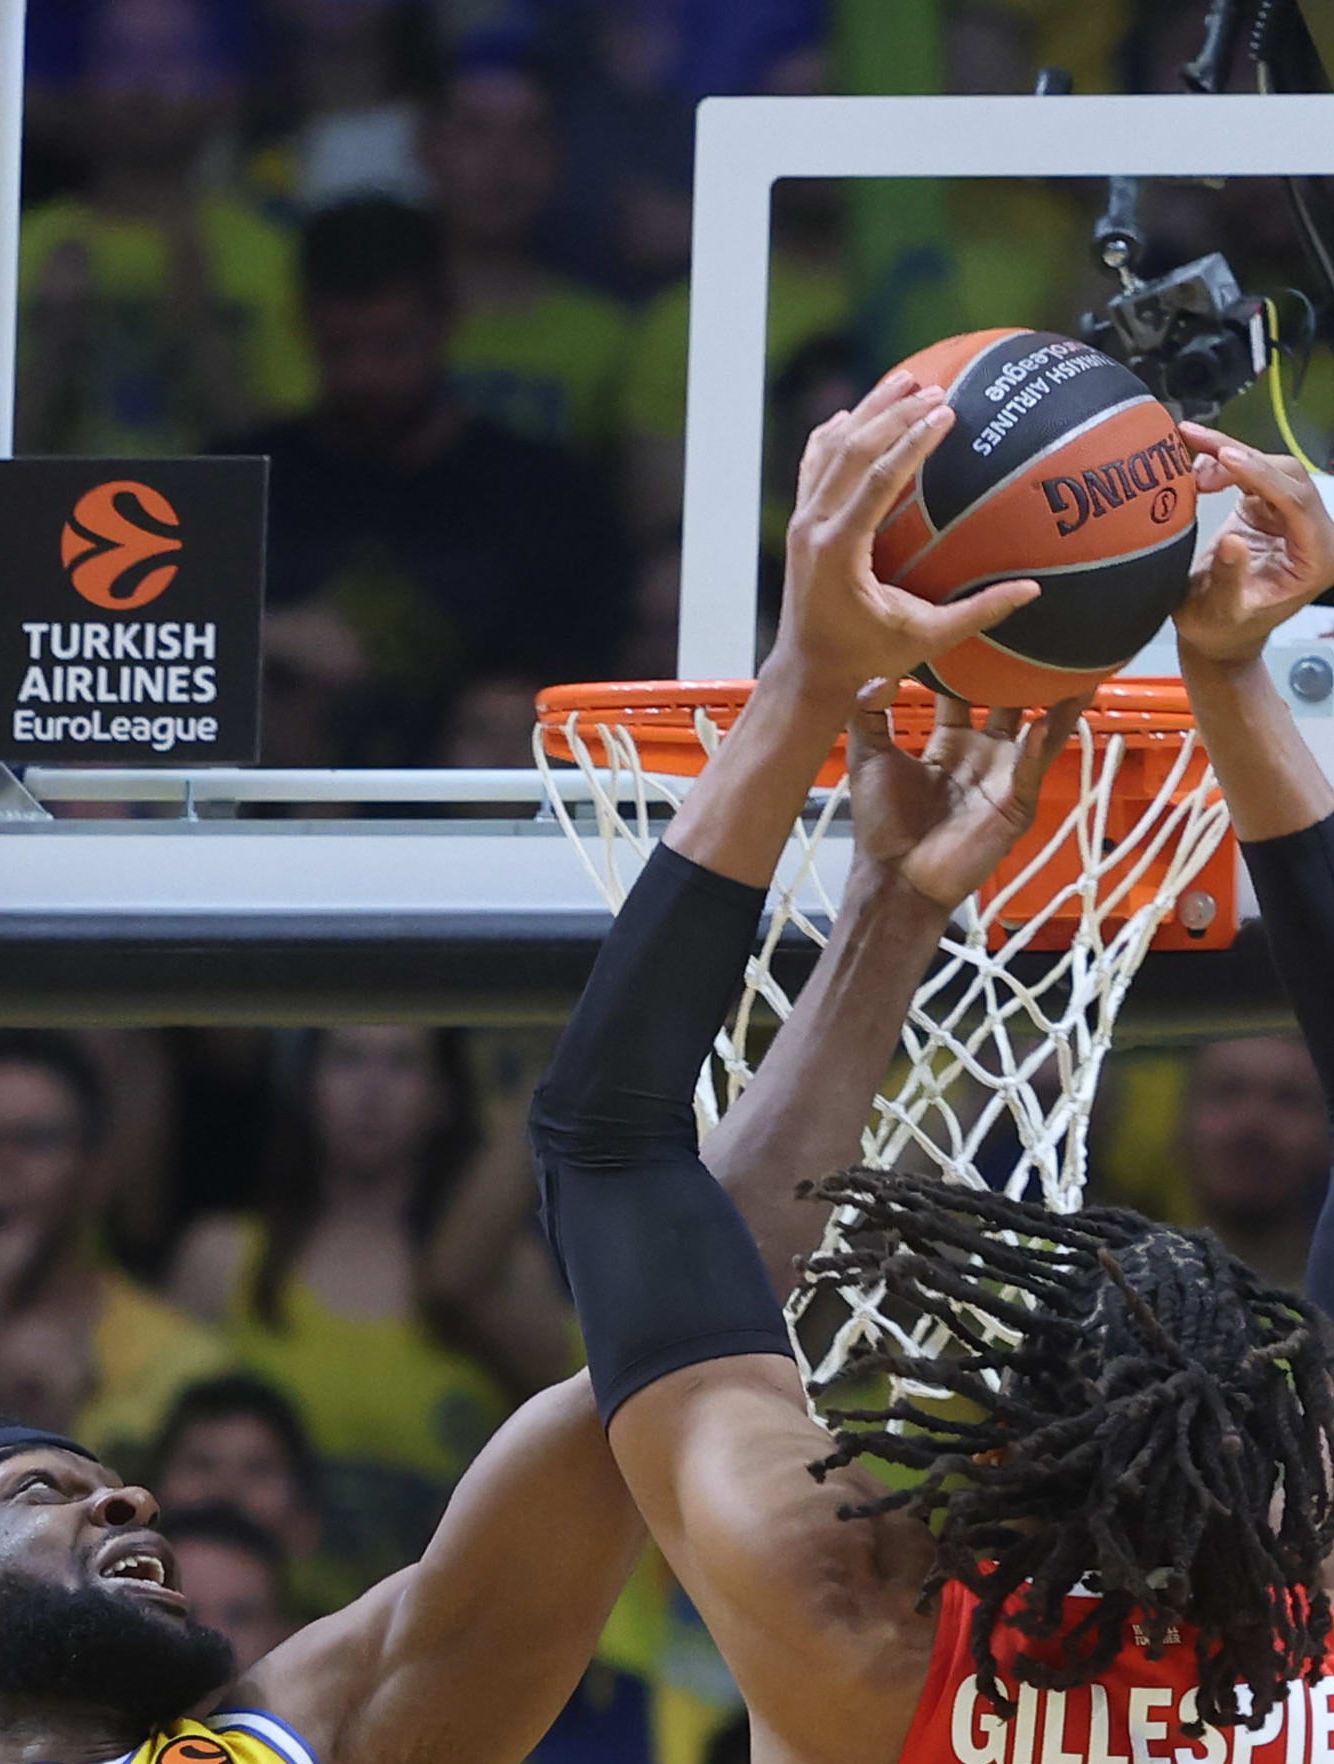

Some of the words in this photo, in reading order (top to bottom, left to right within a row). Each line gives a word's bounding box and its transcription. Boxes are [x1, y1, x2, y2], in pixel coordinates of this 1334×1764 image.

[985, 341, 1097, 401] oLeague
[972, 375, 1051, 457] AIRLINES
[1042, 432, 1192, 537] ALDING
[22, 622, 216, 660] TURKISH
[18, 666, 217, 702] AIRLINES
[13, 710, 218, 751] EuroLeague
